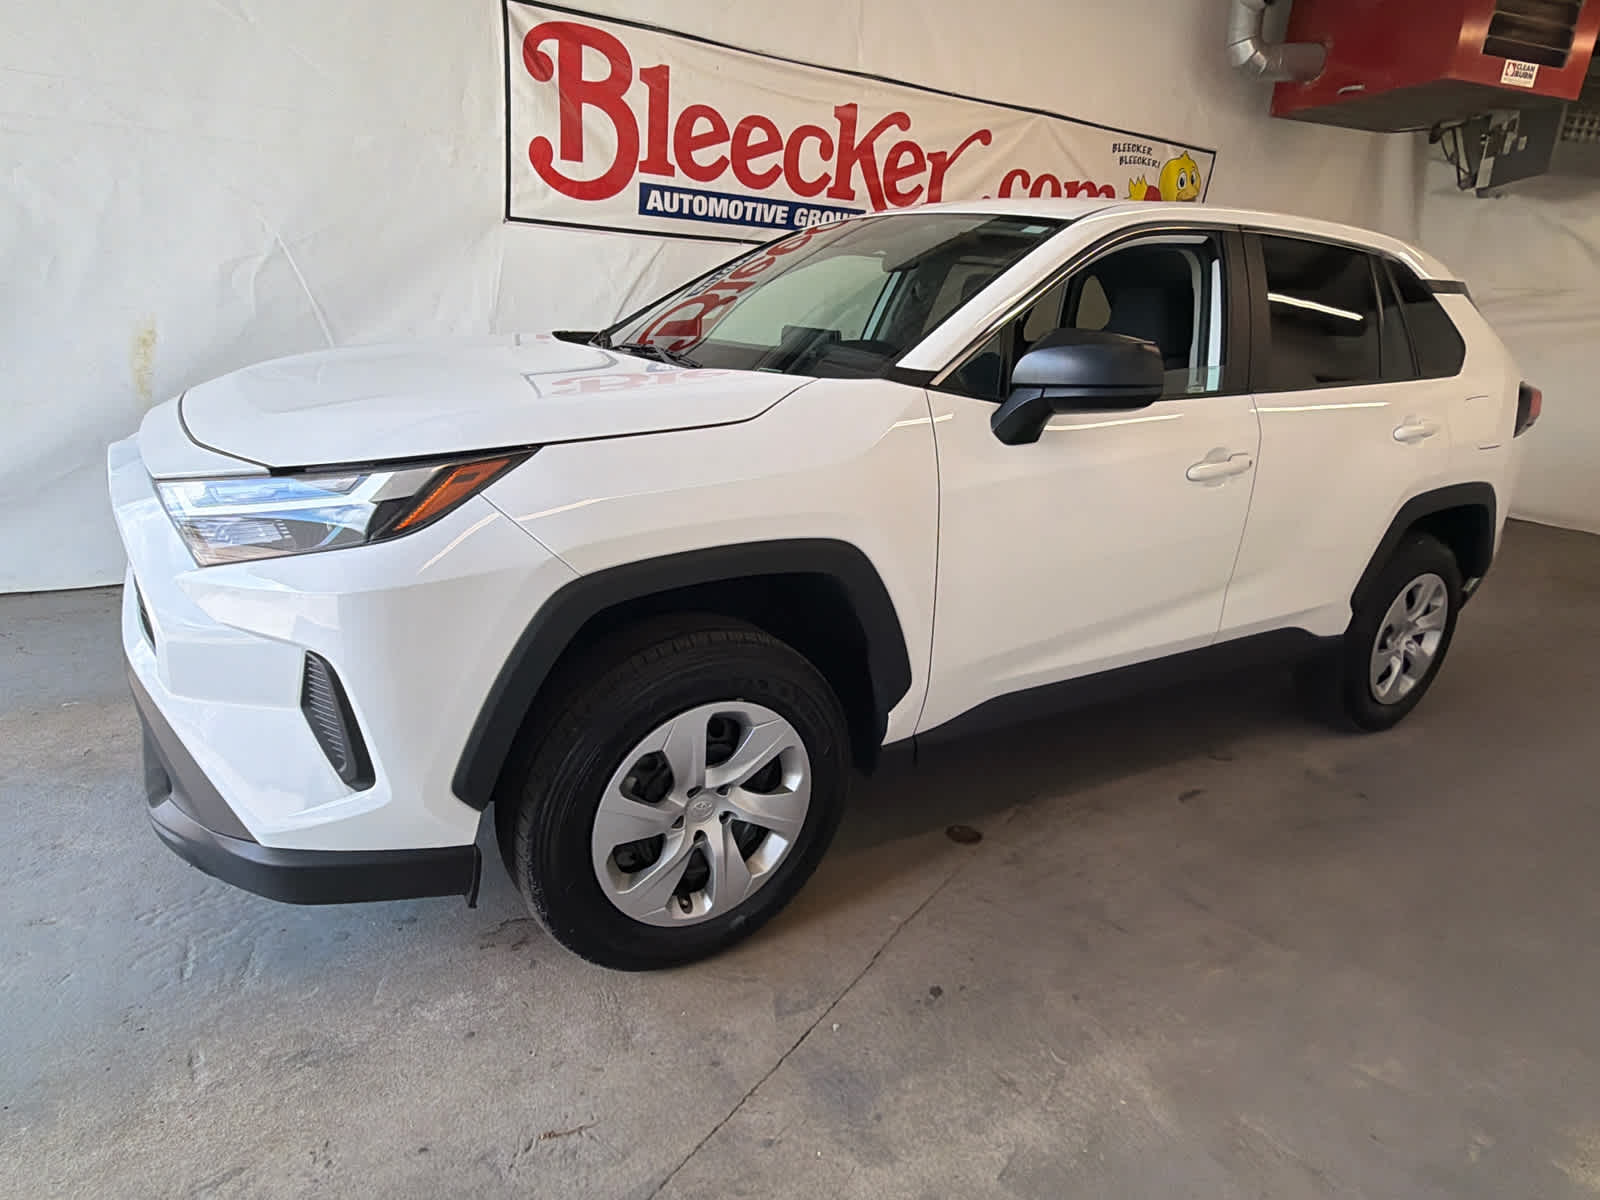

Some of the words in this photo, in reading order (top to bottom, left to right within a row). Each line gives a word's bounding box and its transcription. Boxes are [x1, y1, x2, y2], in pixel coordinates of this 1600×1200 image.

[1516, 63, 1536, 72] CLEAN
[1514, 70, 1533, 80] BURN
[522, 21, 992, 212] Bleecker
[982, 168, 1116, 198] com
[1112, 143, 1153, 156] BLEECKER
[1119, 155, 1161, 169] BLEECKER!
[646, 190, 789, 225] AUTOMOTIVE
[794, 207, 860, 227] GRO
